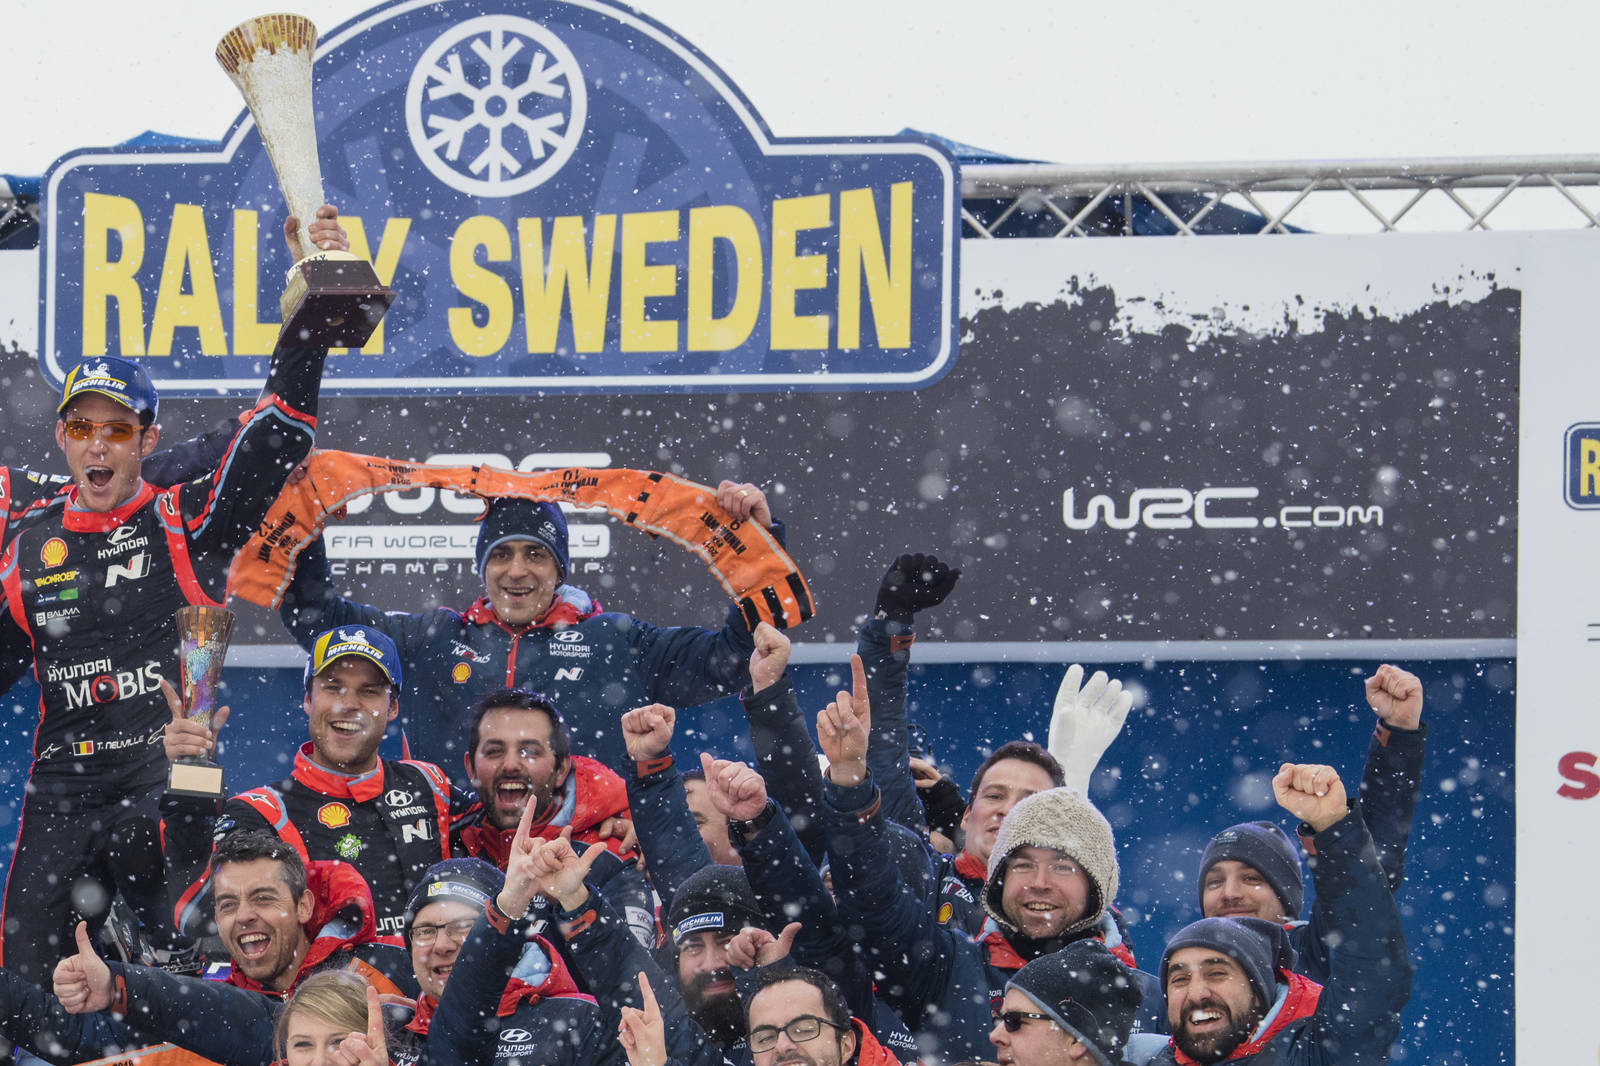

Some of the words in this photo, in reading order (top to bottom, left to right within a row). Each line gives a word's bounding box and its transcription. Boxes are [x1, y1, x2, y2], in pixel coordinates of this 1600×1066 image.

[82, 193, 412, 357] RALY
[447, 181, 914, 357] SWEDEN
[71, 378, 126, 394] MICHELIN
[97, 536, 149, 559] HYUNDAI
[332, 536, 373, 548] FIA
[331, 563, 604, 575] CHAMPIIP
[46, 607, 80, 619] BAUMA
[326, 642, 384, 661] MICHELIN
[550, 643, 590, 652] HYUNDAI
[47, 658, 112, 682] HYUNDAI
[64, 661, 164, 710] MOBIS
[105, 734, 145, 750] NEUVILLE
[680, 912, 722, 930] MICHELIN
[497, 1043, 536, 1052] YUNDAI
